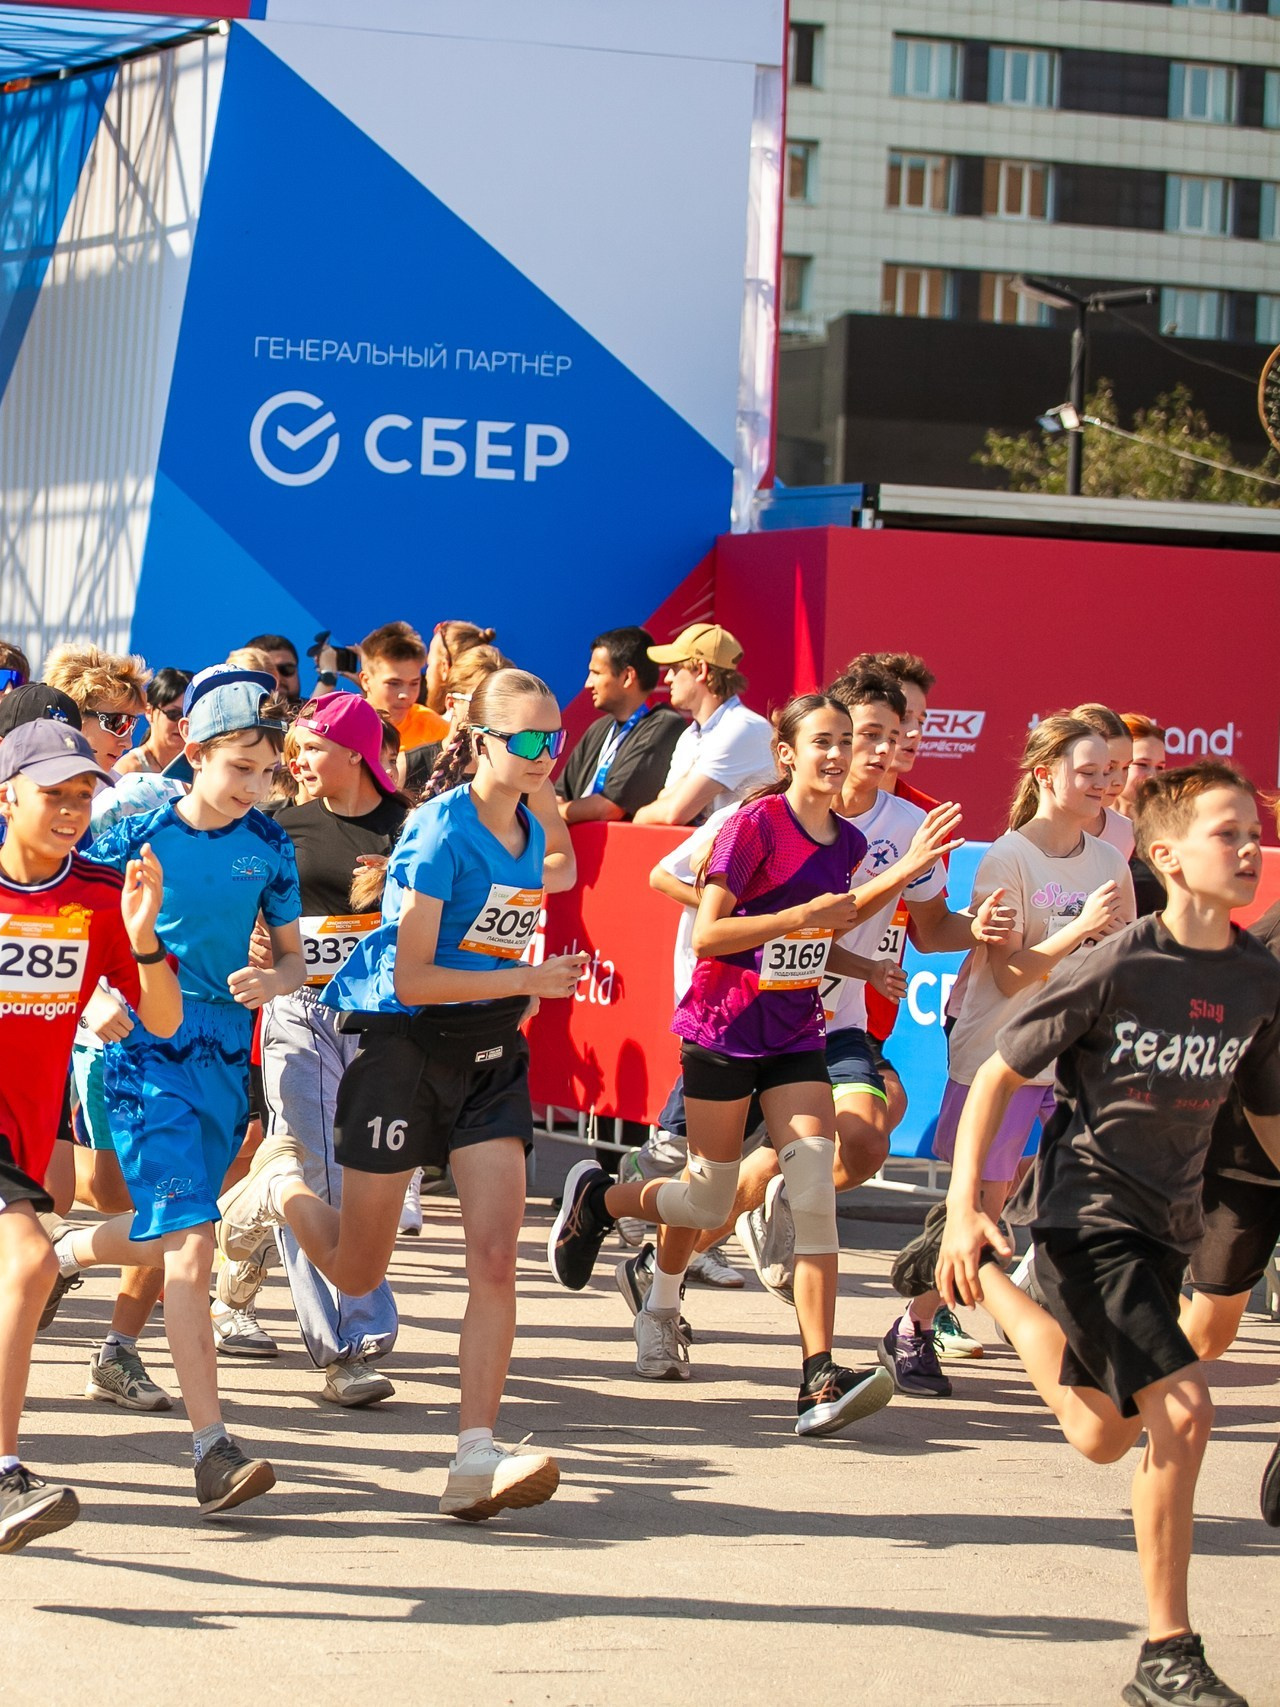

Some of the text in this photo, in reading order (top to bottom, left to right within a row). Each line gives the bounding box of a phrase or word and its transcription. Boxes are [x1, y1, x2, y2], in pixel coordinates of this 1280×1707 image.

[254, 335, 572, 377] ГЕНЕРАЛЬНЫЙ ПАРТНЁР
[364, 413, 570, 482] СБЕР
[923, 713, 978, 735] RK
[303, 936, 361, 965] 333
[768, 942, 827, 970] 3169
[366, 1115, 409, 1151] 16
